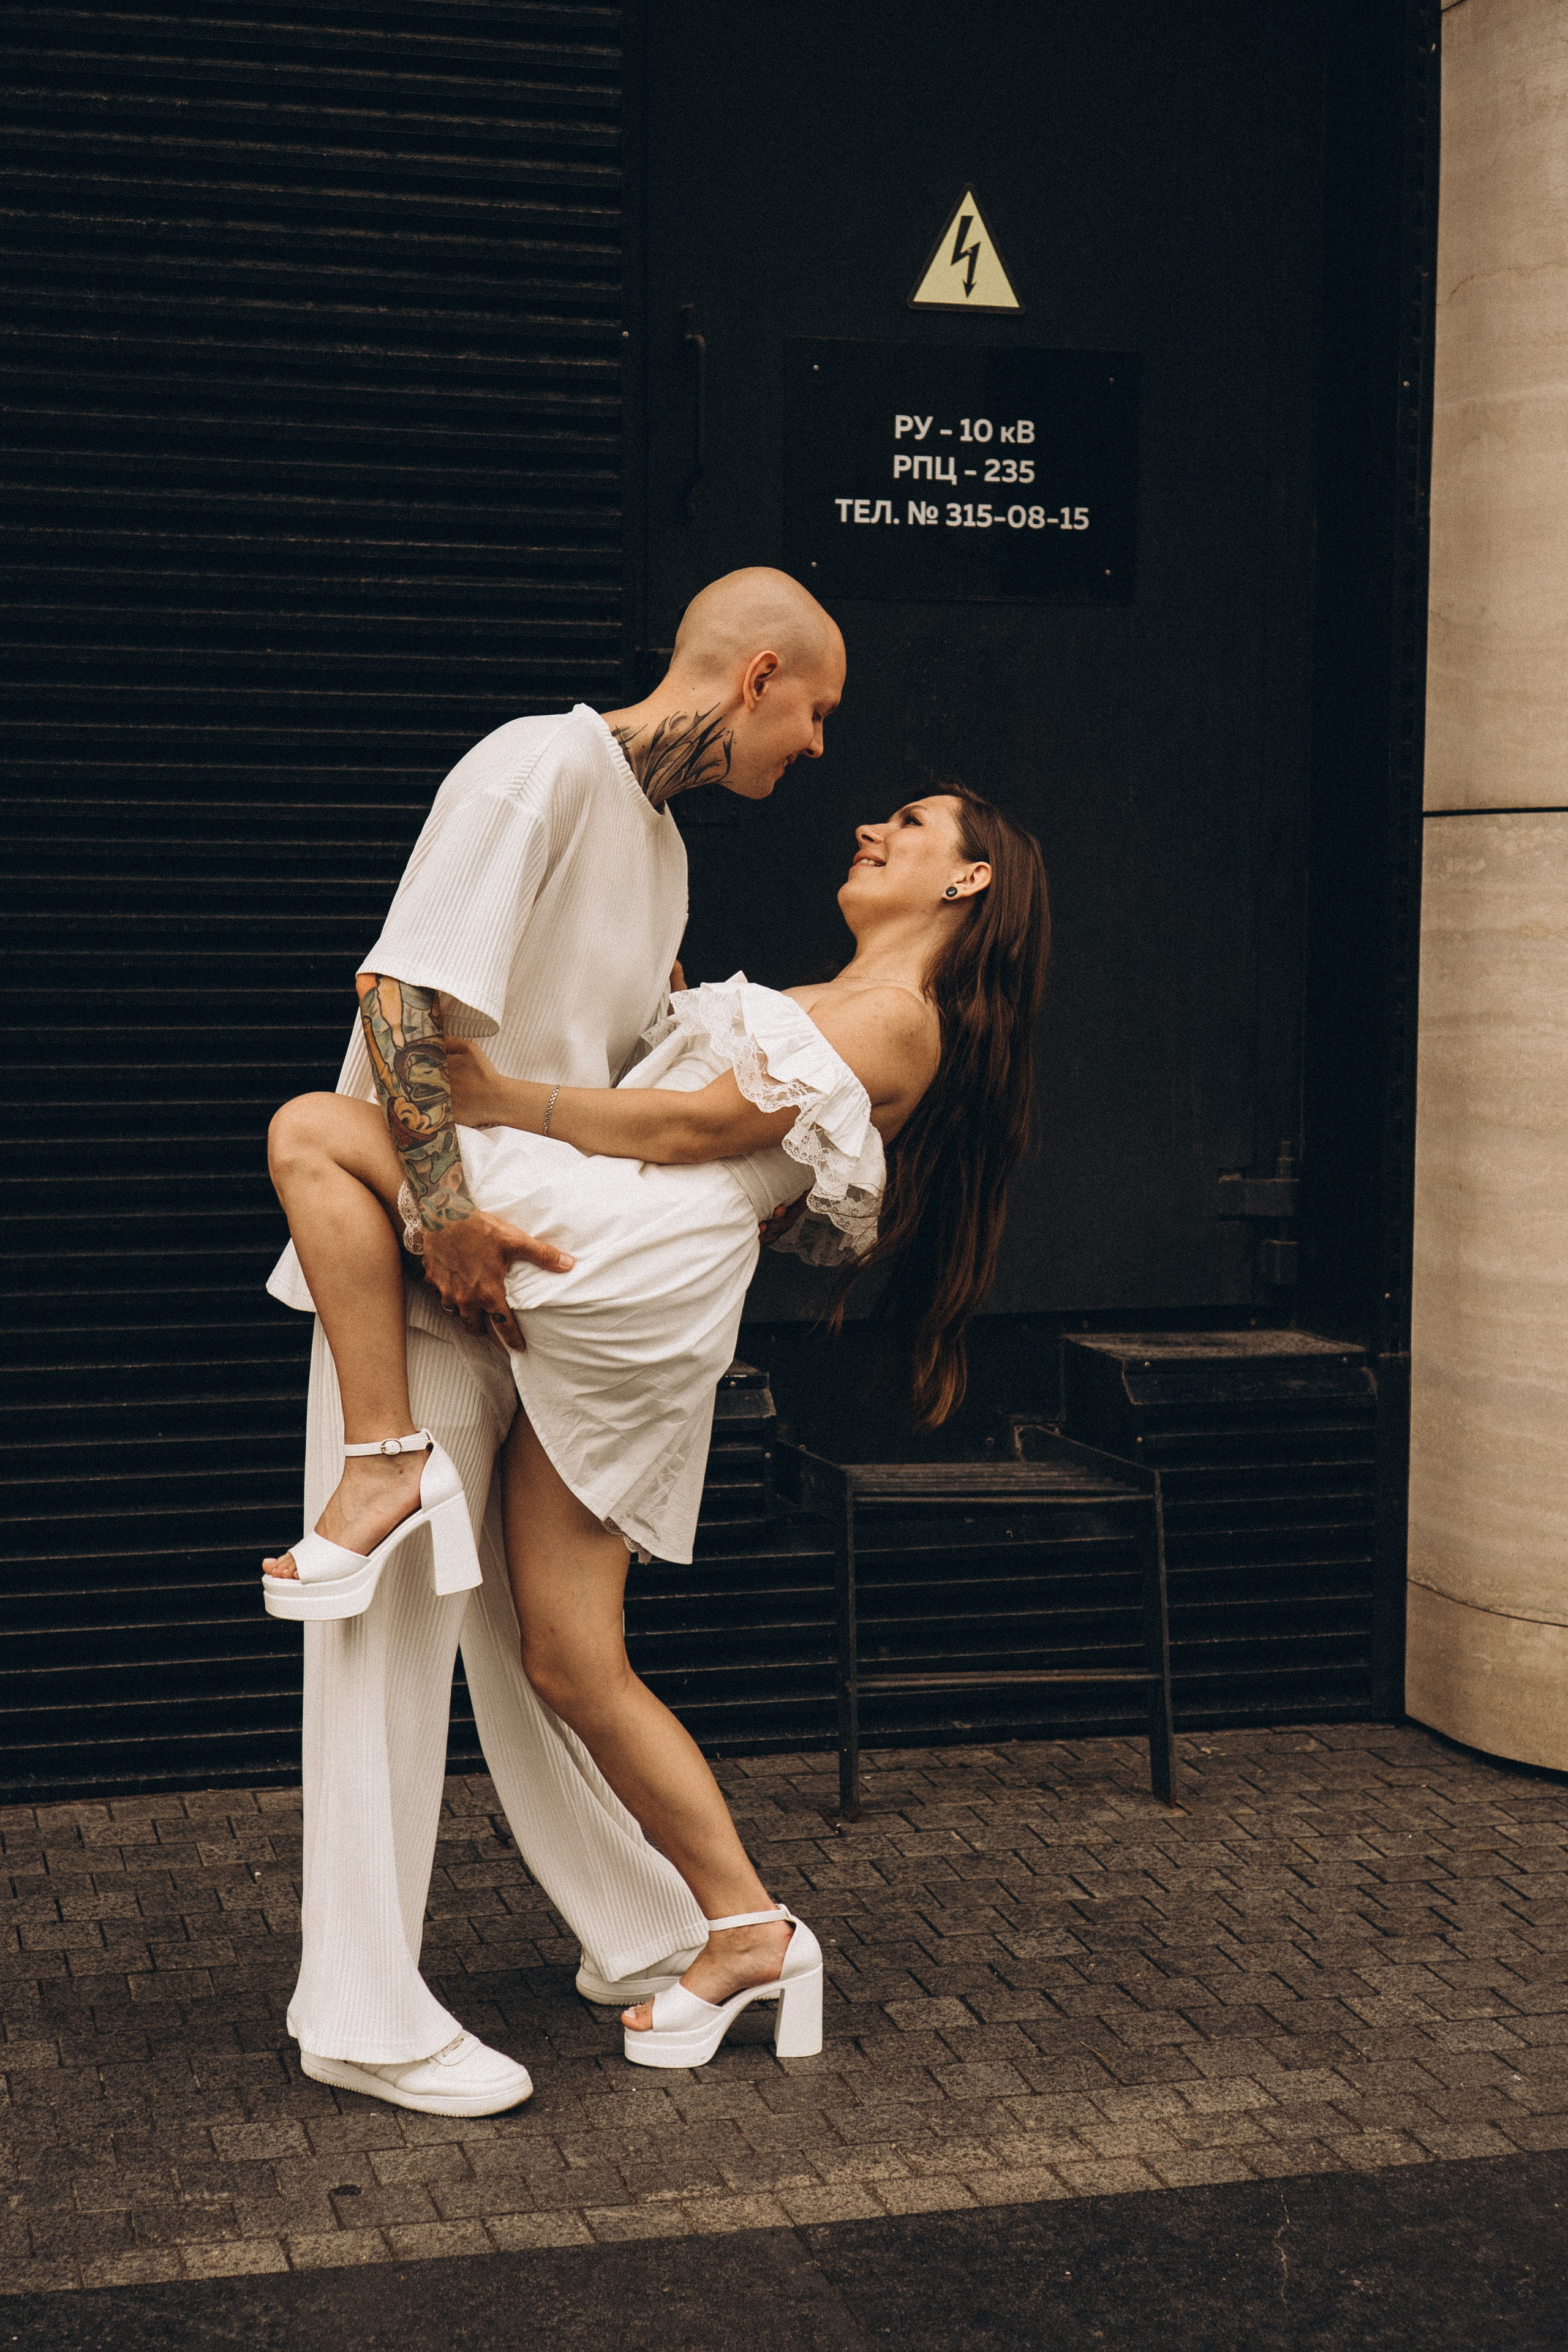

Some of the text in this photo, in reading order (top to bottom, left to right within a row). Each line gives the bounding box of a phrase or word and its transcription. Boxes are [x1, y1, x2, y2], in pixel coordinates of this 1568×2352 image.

[895, 414, 933, 440] РУ
[960, 418, 993, 442] 10
[1000, 420, 1035, 443] кВ
[894, 454, 957, 485] РПЦ
[984, 458, 1035, 483] 235
[834, 498, 1089, 530] ТЕЛ. № 315-08-15
